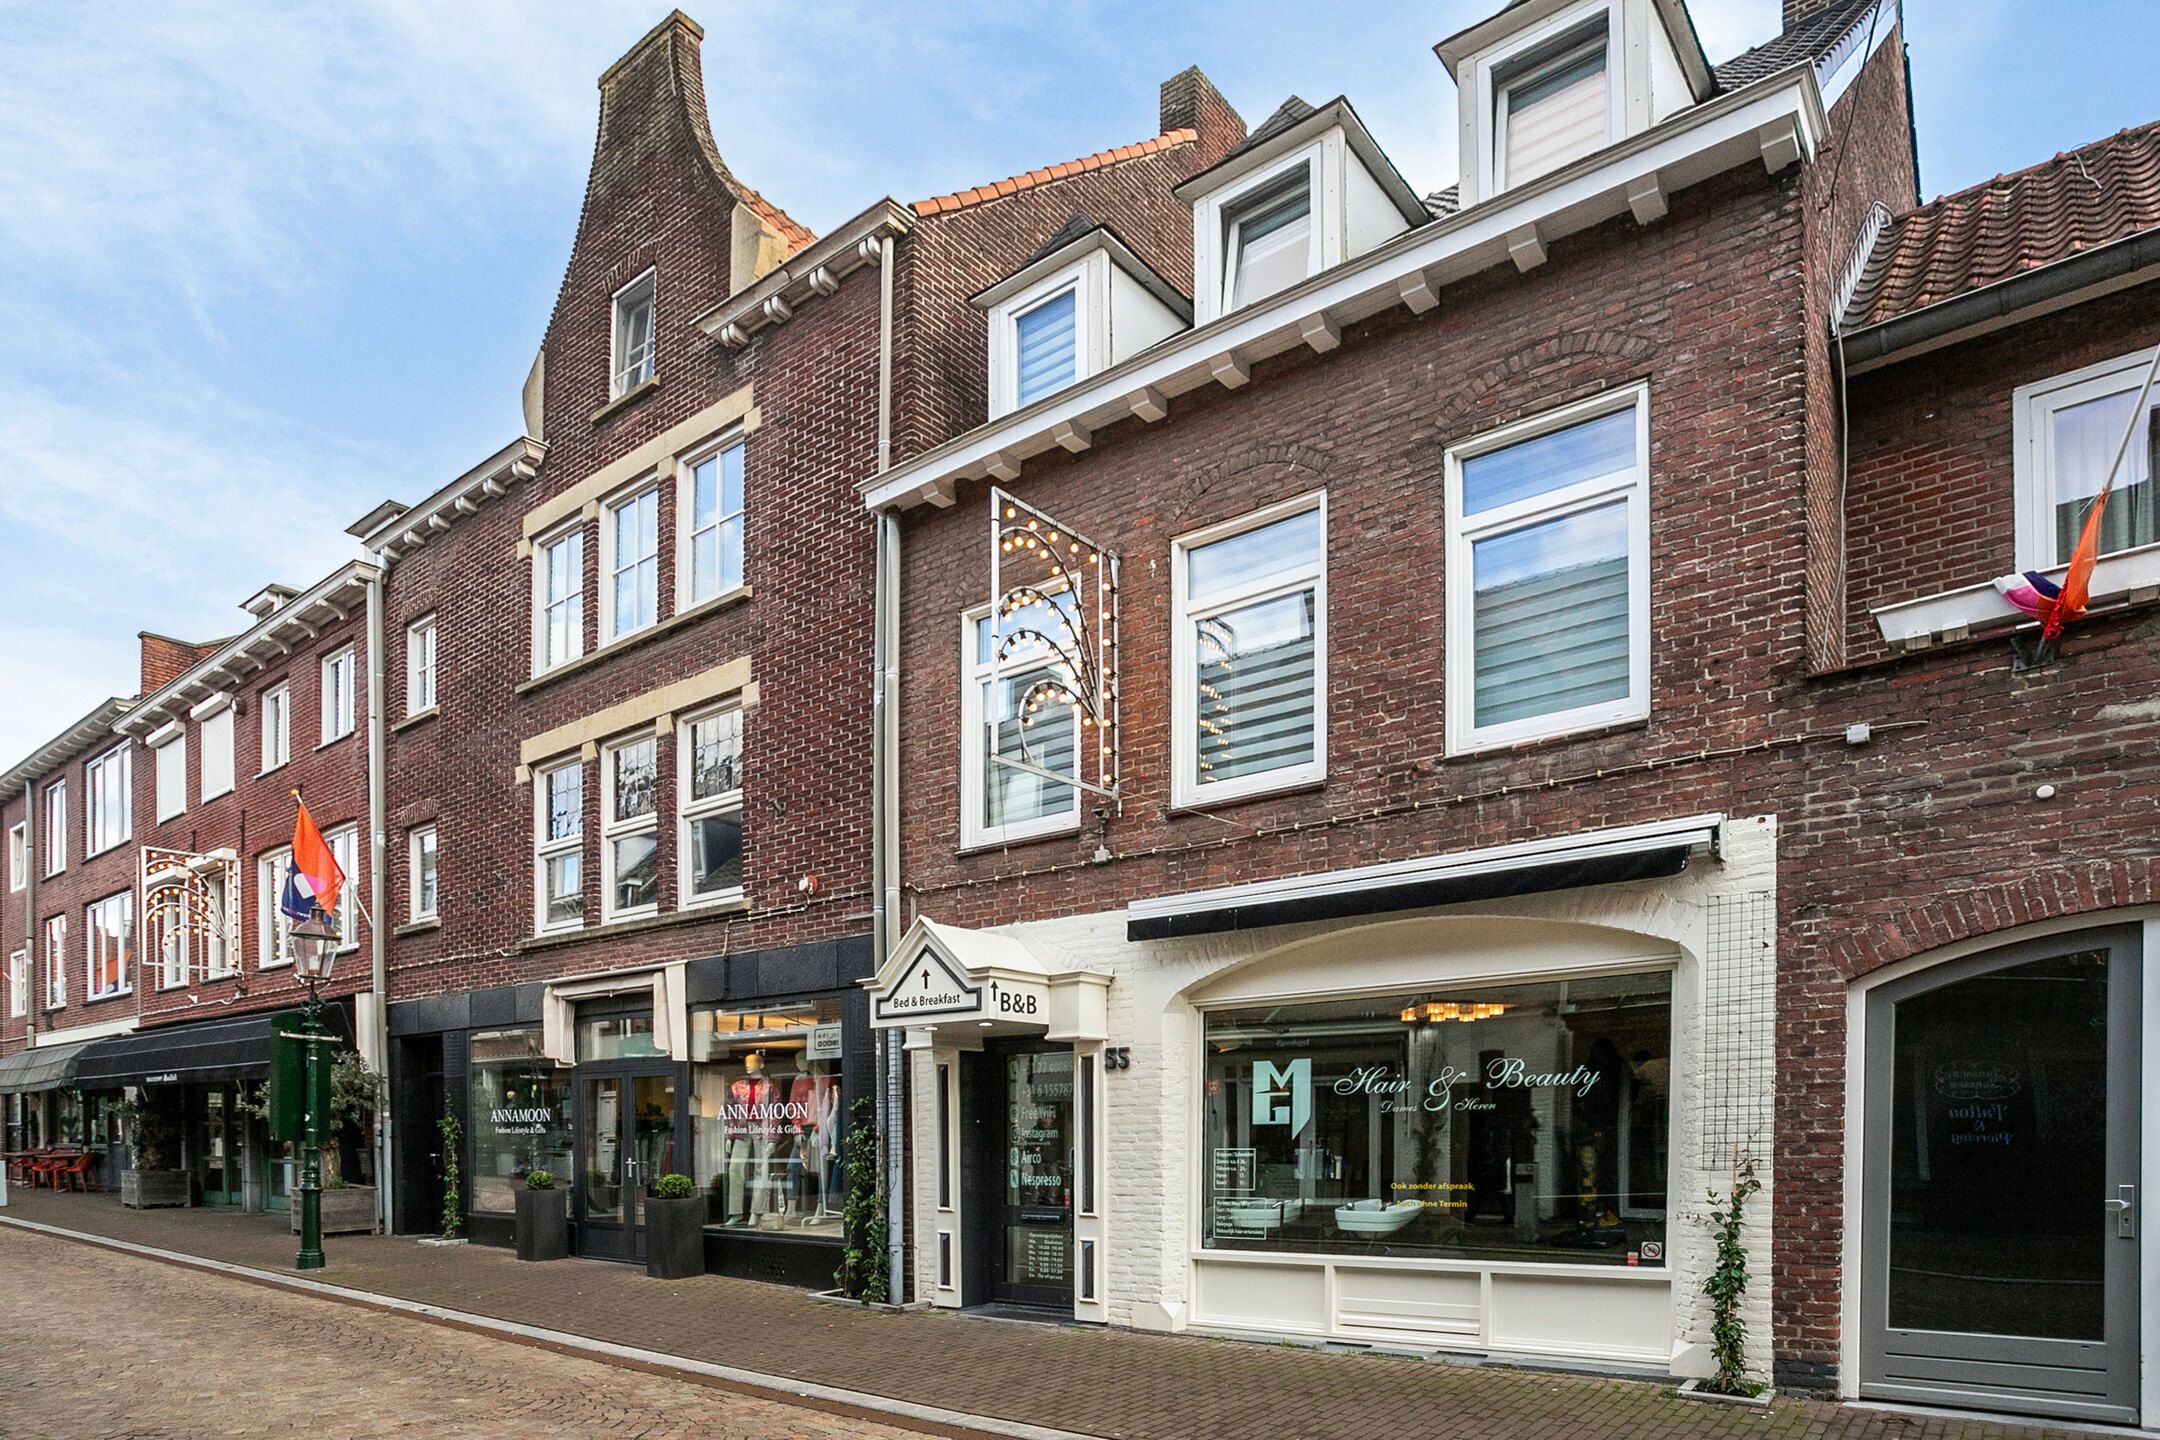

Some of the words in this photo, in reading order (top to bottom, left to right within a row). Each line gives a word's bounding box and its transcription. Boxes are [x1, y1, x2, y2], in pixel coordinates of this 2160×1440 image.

[893, 997, 910, 1008] Bed
[911, 997, 918, 1006] &
[919, 993, 961, 1006] Breakfast
[1000, 992, 1037, 1014] B&B
[1104, 1046, 1130, 1070] 55
[1333, 1066, 1412, 1096] Hair
[1423, 1066, 1467, 1111] &
[1485, 1058, 1600, 1097] Beauty
[716, 1102, 809, 1121] ANNAMOON
[1381, 1101, 1418, 1114] Dames
[1454, 1098, 1497, 1112] Heren
[490, 1108, 551, 1122] ANNAMOON
[495, 1126, 511, 1134] Fashion
[530, 1126, 535, 1134] &
[724, 1125, 747, 1134] Fashion
[748, 1125, 776, 1136] Lifestyle
[776, 1125, 783, 1134] &
[784, 1124, 801, 1135] Gifts
[1021, 1128, 1058, 1141] Instagram
[1021, 1150, 1041, 1164] Airco
[1021, 1172, 1062, 1189] Nespresso
[1408, 1182, 1436, 1190] zonder
[1440, 1200, 1468, 1208] Termin
